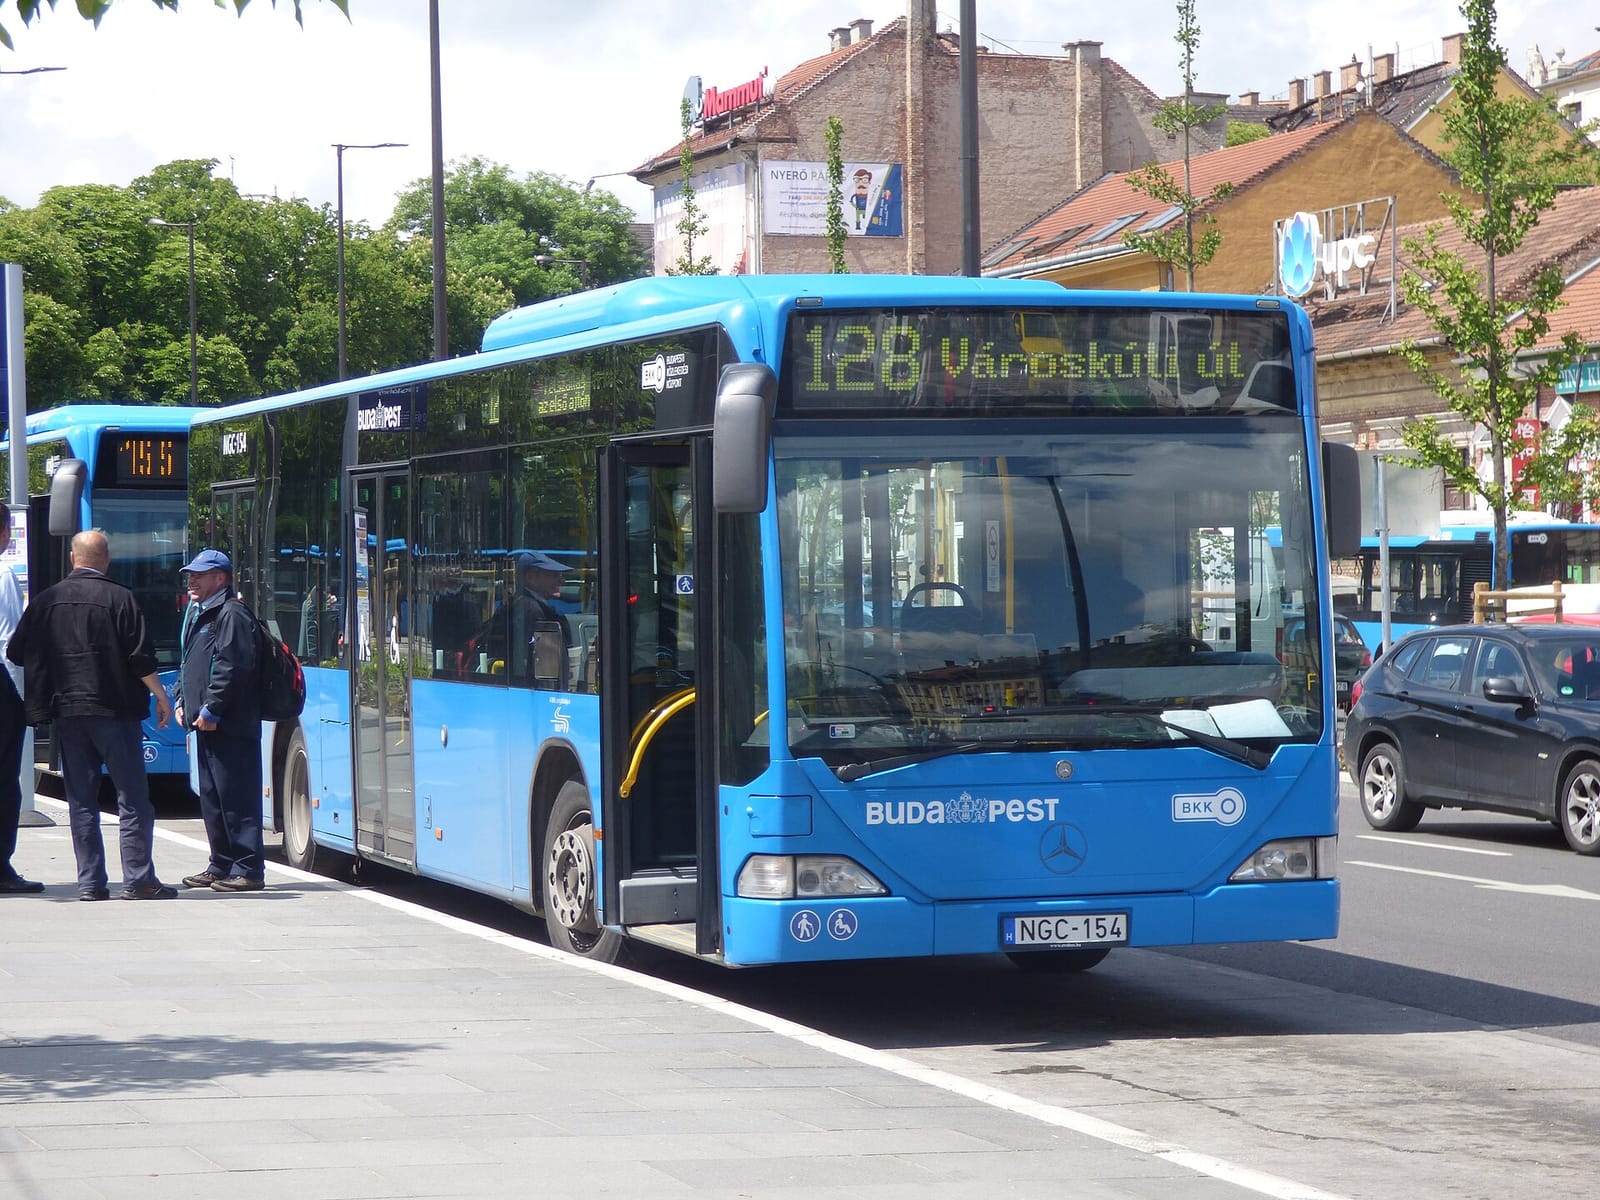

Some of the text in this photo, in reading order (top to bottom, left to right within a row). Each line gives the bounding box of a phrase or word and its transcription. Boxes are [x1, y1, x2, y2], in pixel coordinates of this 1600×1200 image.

[703, 67, 767, 119] Mammut
[1322, 234, 1375, 288] upc
[806, 325, 1245, 391] 128 Városkúti út
[1182, 801, 1213, 814] BKK
[1006, 932, 1013, 941] H
[1020, 916, 1122, 942] NGC-154
